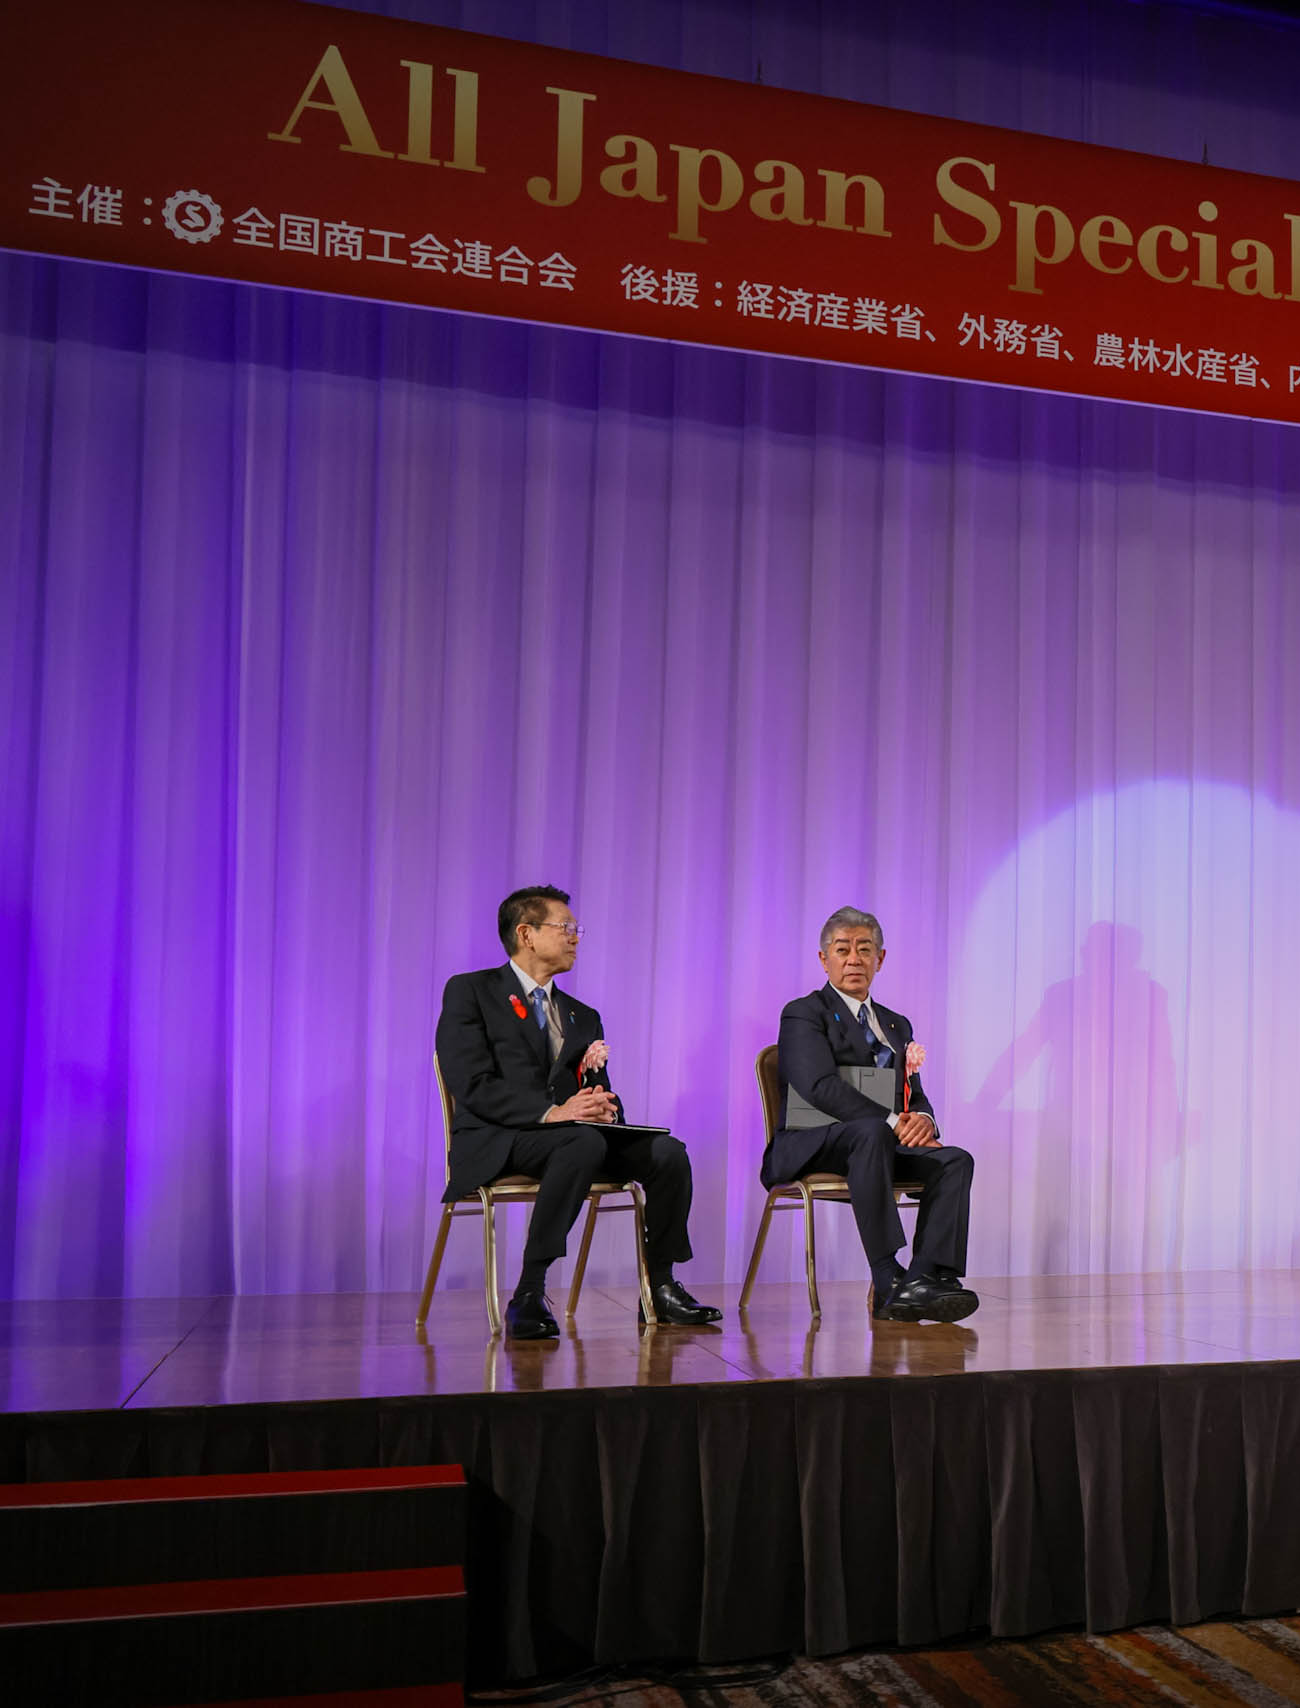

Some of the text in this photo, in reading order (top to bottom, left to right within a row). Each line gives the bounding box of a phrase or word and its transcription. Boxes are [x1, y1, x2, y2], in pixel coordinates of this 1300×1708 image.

[268, 44, 487, 174] All
[526, 86, 894, 245] Japan
[231, 206, 578, 292] 全国商工会連合会
